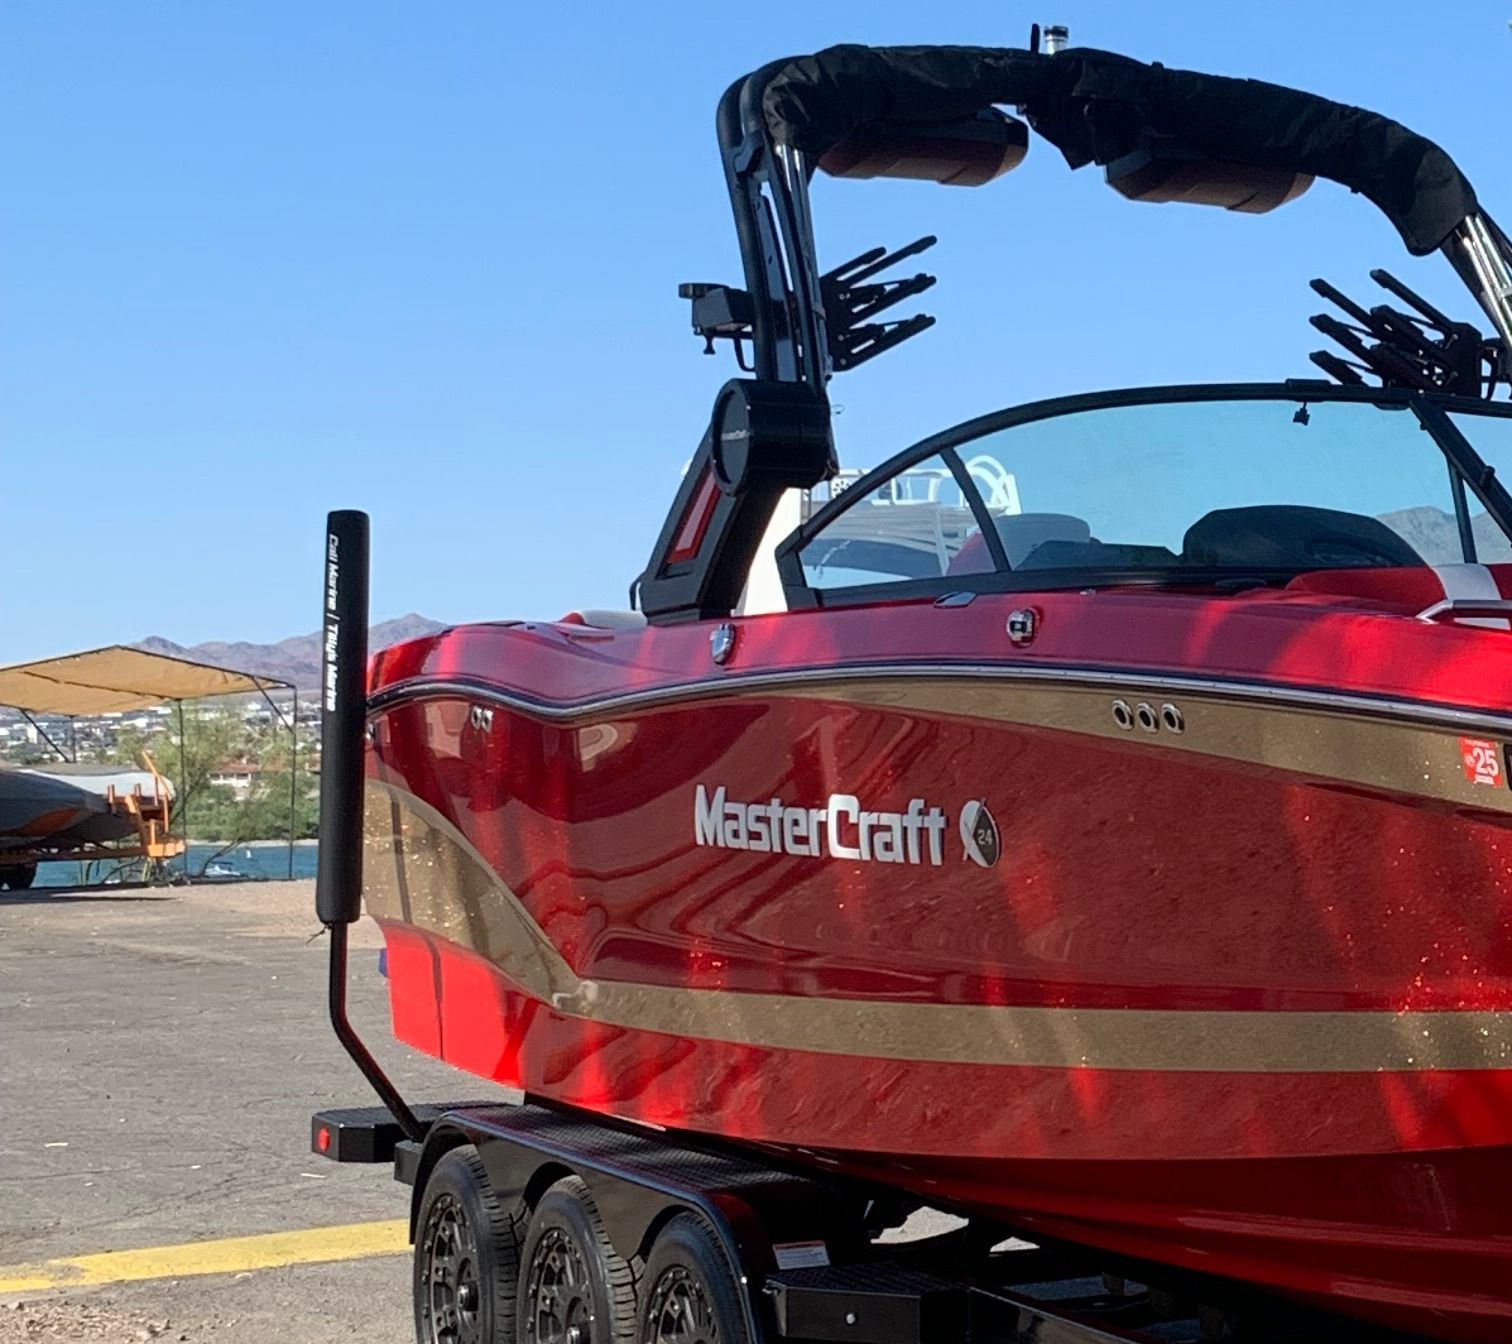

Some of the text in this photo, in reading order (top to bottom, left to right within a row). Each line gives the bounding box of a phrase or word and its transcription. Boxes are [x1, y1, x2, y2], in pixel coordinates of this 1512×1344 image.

[327, 563, 339, 610] Marine
[325, 663, 338, 711] Marine
[1472, 747, 1498, 776] 25
[694, 784, 946, 866] MasterCraft
[977, 828, 993, 845] 24
